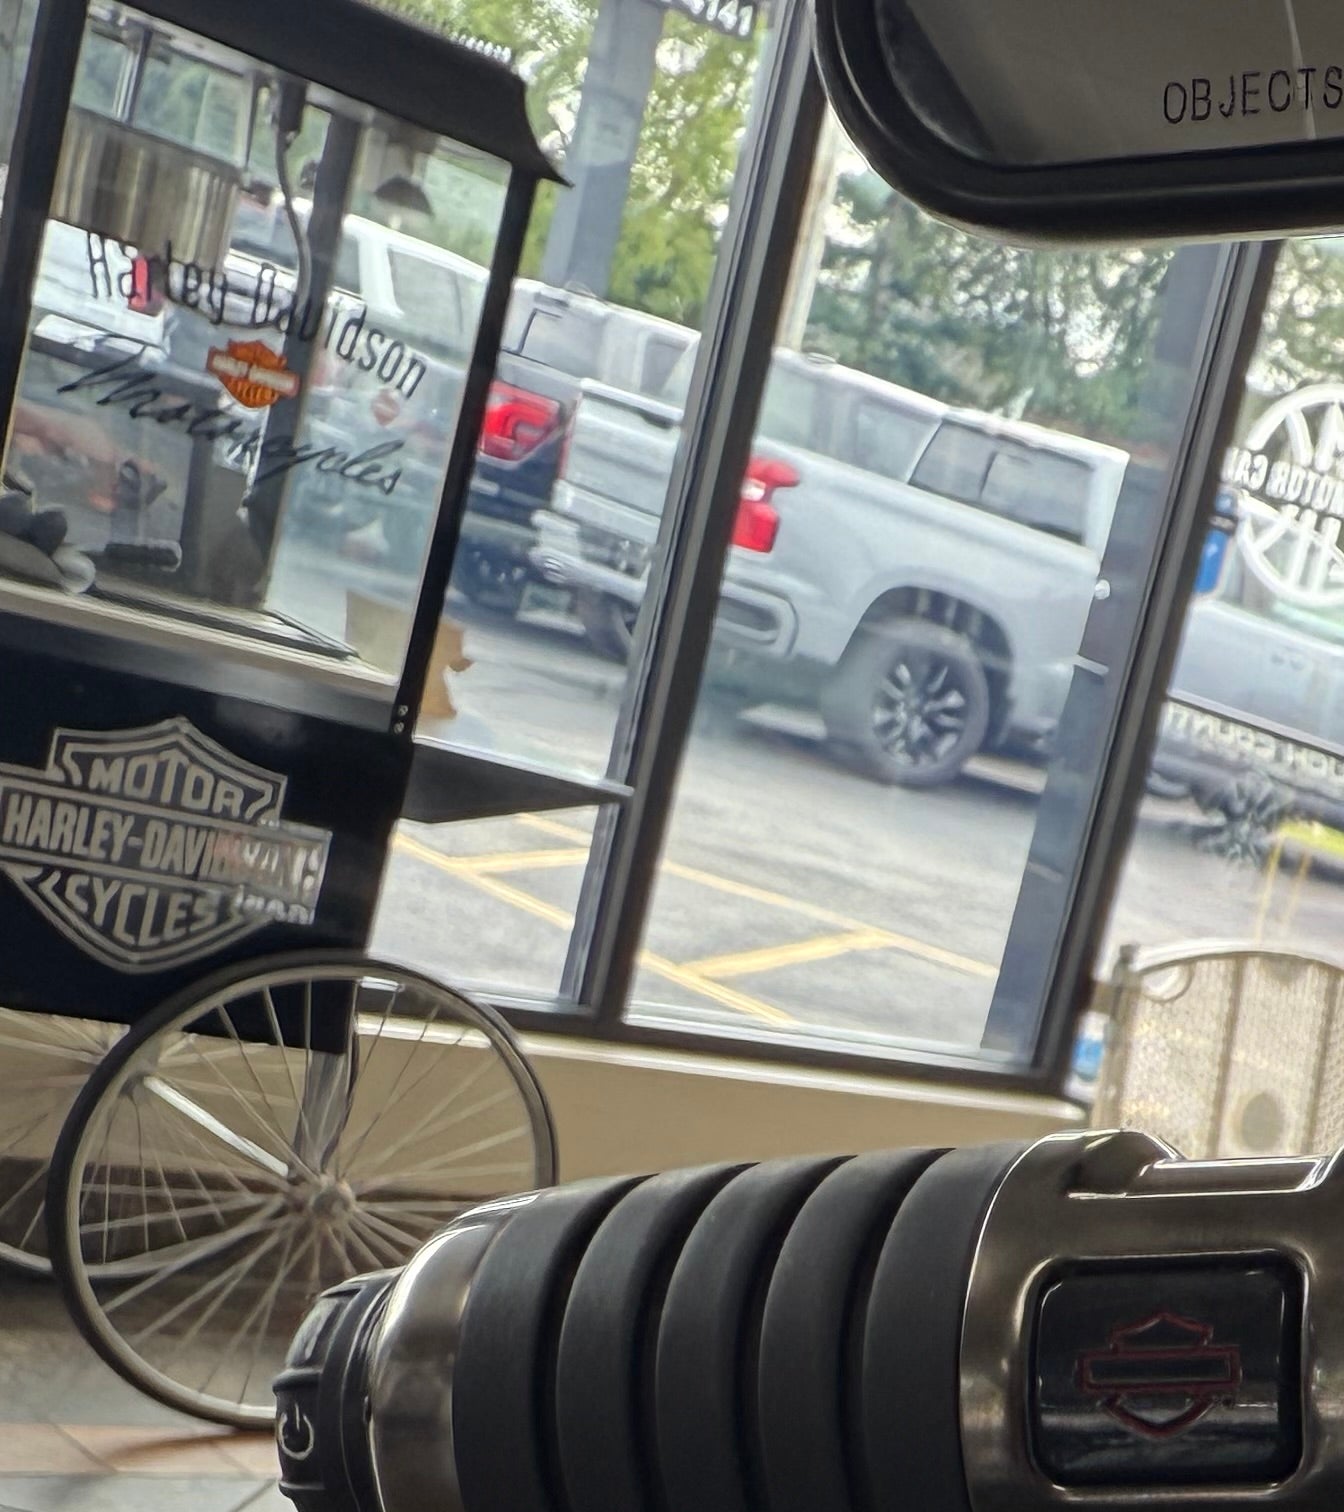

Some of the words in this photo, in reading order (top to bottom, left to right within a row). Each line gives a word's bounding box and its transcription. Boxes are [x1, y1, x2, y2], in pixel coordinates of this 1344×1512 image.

[1163, 65, 1344, 124] OBJECTS
[87, 230, 228, 325] Harley
[87, 748, 246, 819] MOTOR
[63, 873, 222, 949] CYCLES
